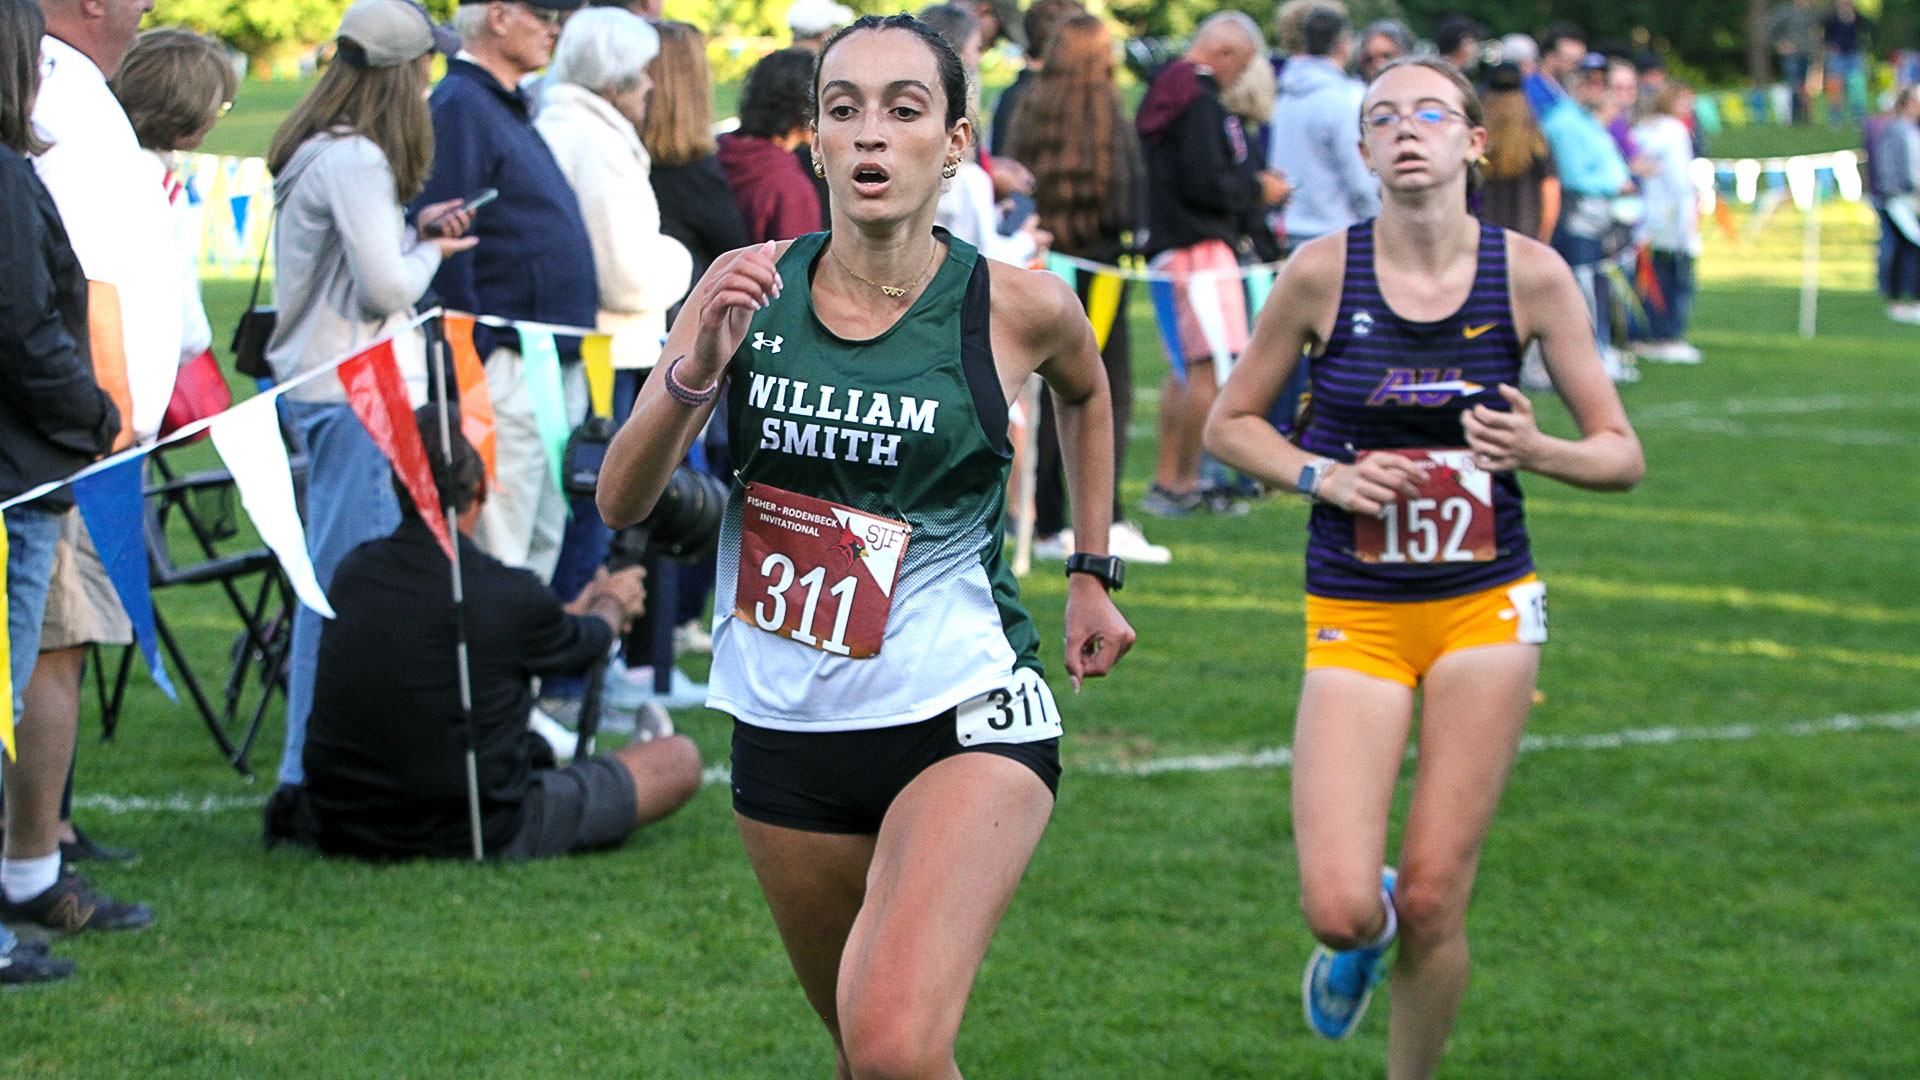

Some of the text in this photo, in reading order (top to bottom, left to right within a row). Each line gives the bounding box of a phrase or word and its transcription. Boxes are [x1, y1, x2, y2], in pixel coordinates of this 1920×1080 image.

[749, 371, 939, 434] WILLIAM
[1366, 368, 1462, 407] AU
[760, 418, 902, 466] SMITH
[747, 496, 777, 512] FISHER
[783, 506, 838, 528] RODENBECK
[760, 513, 820, 537] INVITATIONAL
[1378, 496, 1474, 562] 152
[866, 524, 902, 550] SJF
[754, 553, 858, 656] 311
[987, 680, 1047, 730] 311
